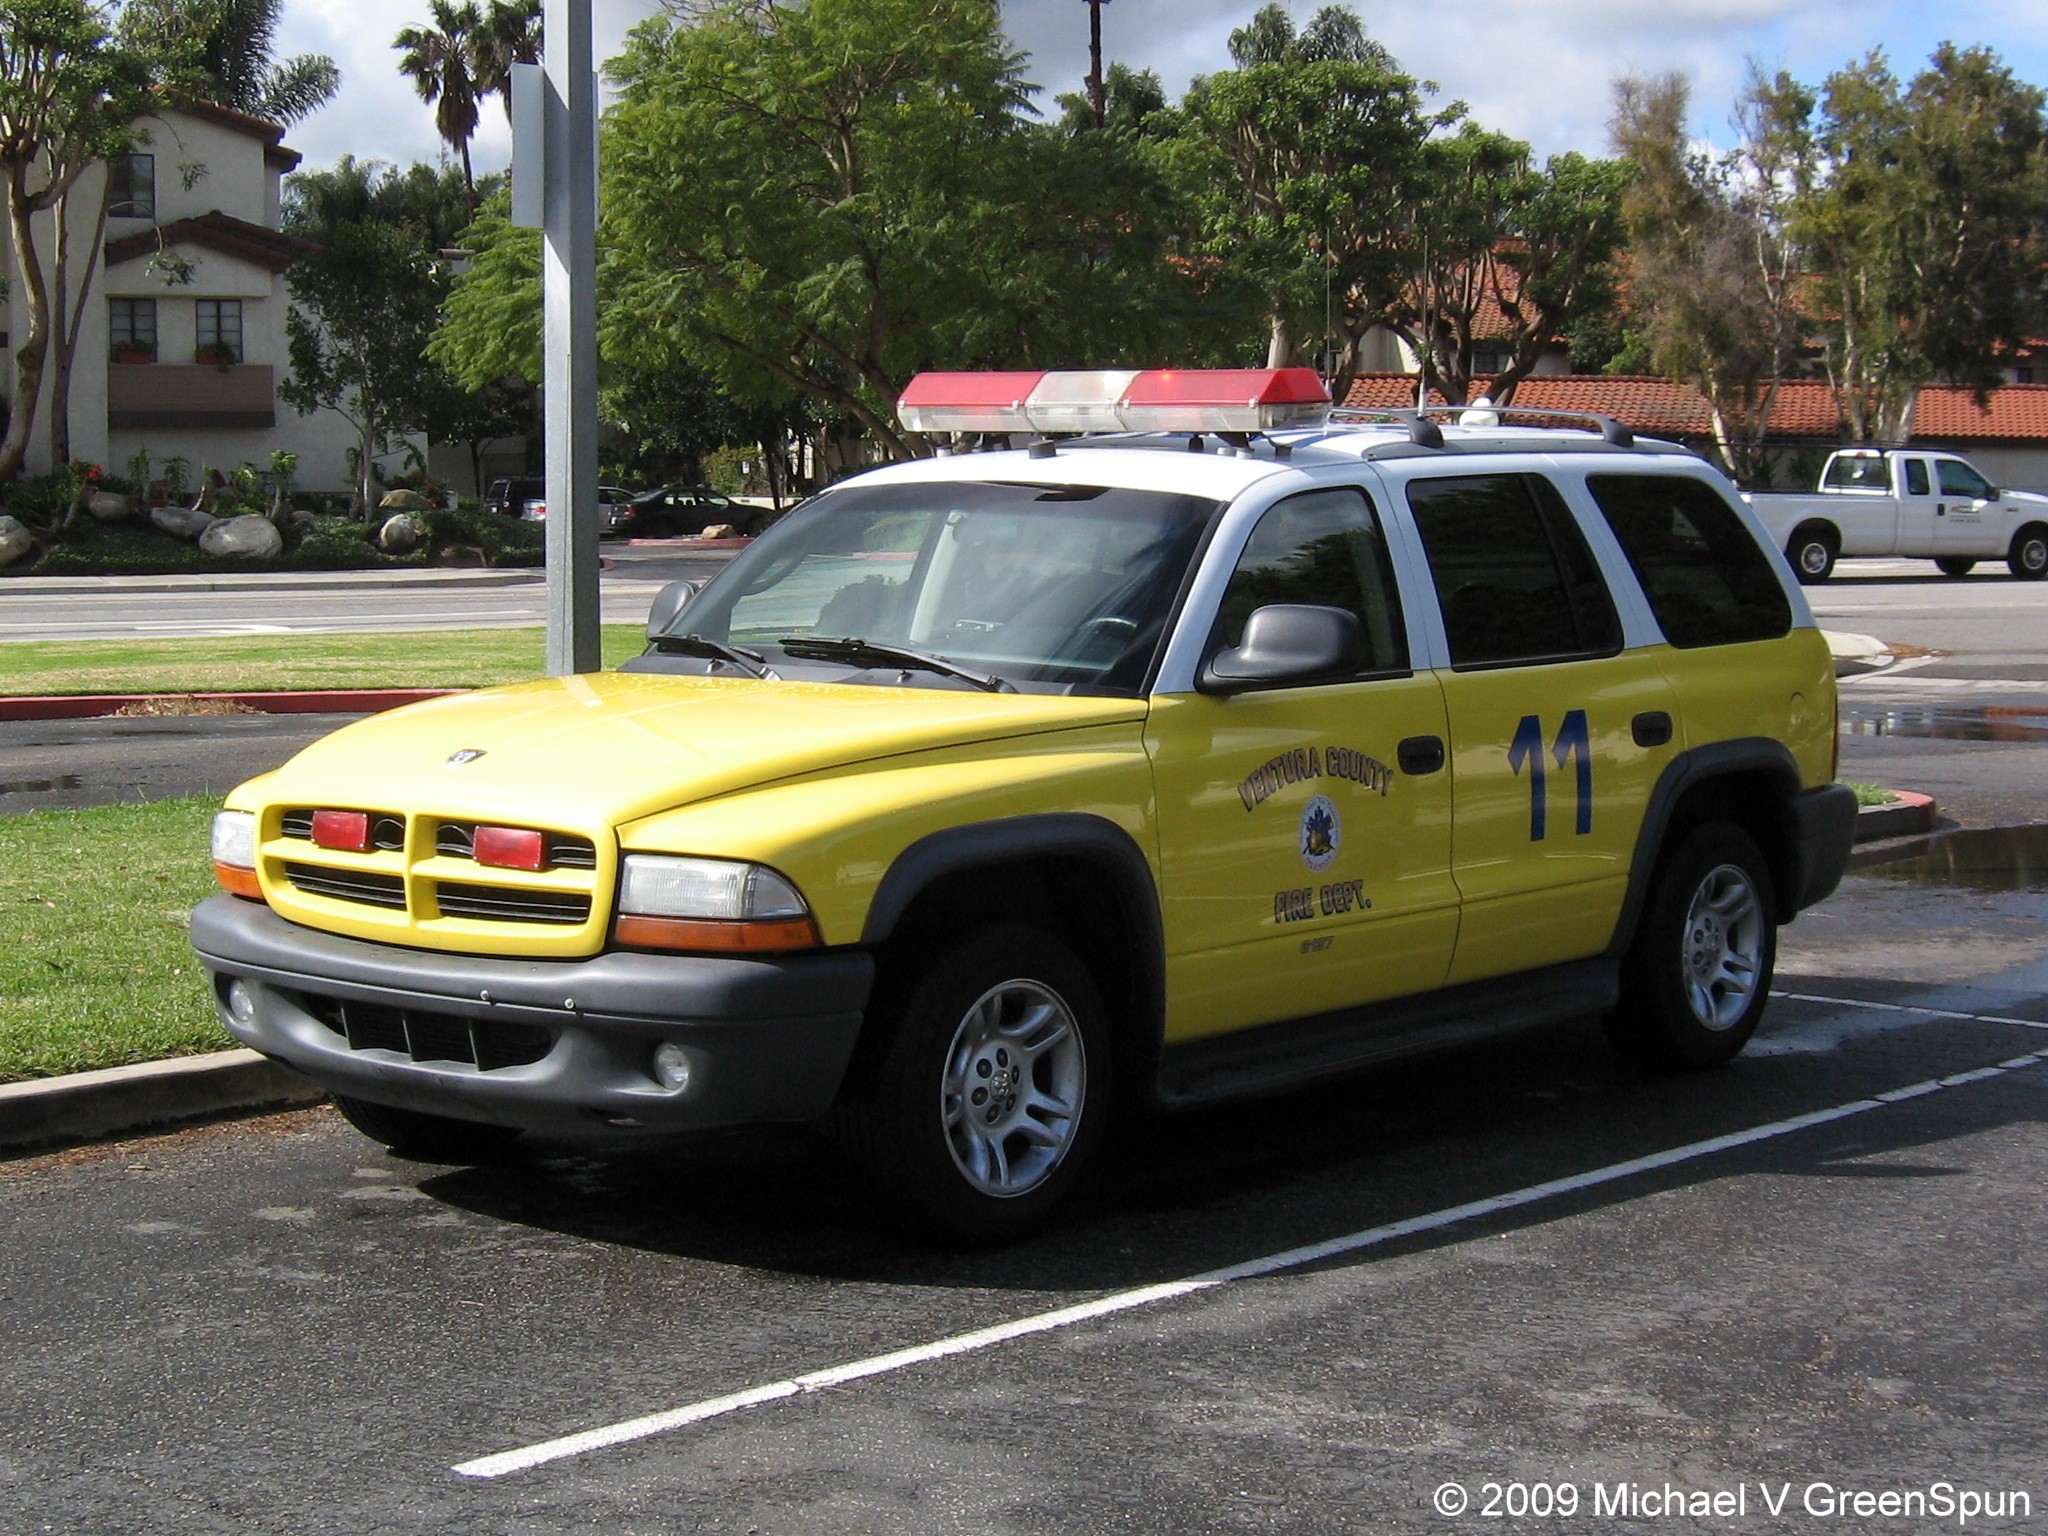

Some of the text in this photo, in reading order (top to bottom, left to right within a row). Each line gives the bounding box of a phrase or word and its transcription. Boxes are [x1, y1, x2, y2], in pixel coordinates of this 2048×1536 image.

[1238, 746, 1394, 812] VENTURA COUNTY
[1508, 709, 1592, 841] 11
[1275, 879, 1372, 923] FIRE DEPT.
